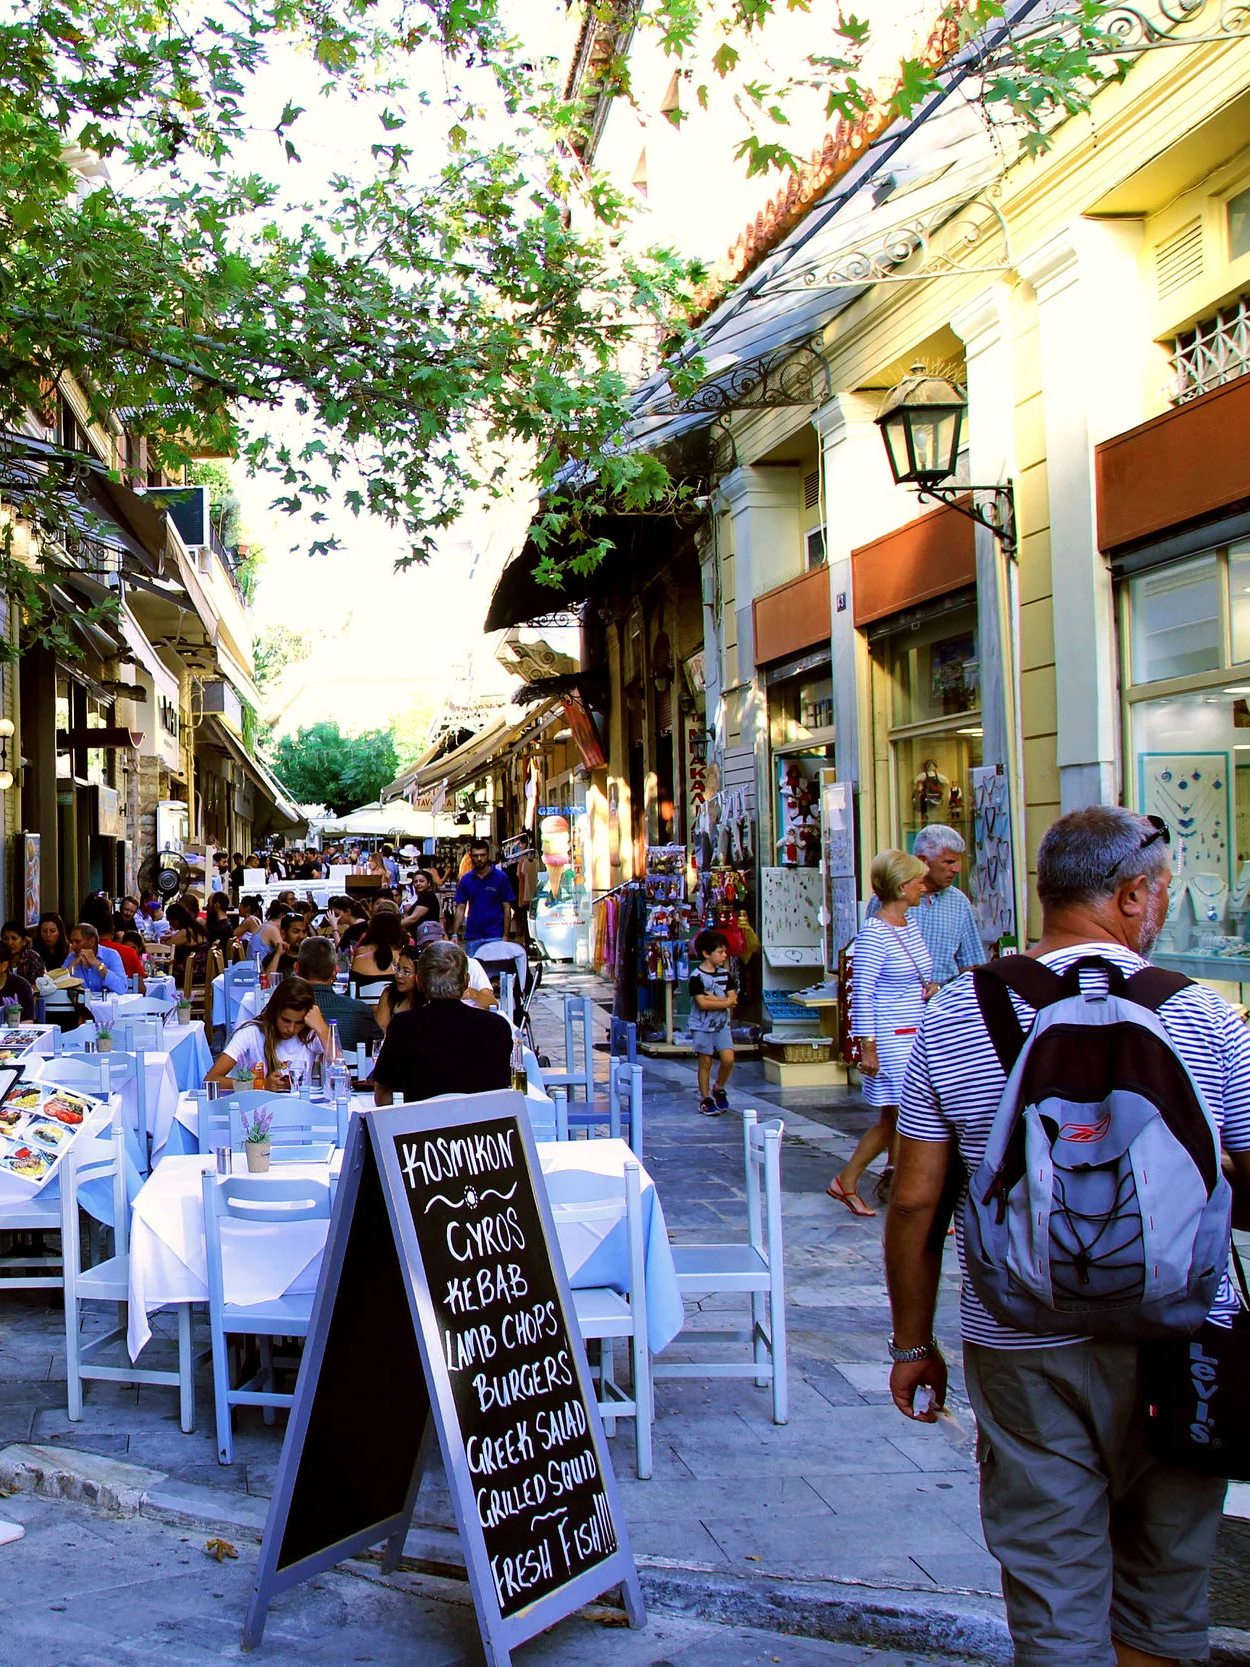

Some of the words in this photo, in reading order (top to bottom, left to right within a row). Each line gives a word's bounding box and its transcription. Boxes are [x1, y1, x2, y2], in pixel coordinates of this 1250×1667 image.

[402, 1128, 515, 1189] KOSMIKON
[446, 1206, 526, 1262] GYROS
[443, 1263, 529, 1315] KEBAB
[445, 1324, 497, 1371] LAMB
[501, 1300, 558, 1349] CHOPS
[472, 1350, 573, 1413] BURGERS
[466, 1420, 535, 1475] GREEK
[535, 1399, 586, 1450] SALAD
[477, 1473, 547, 1528] GRILLED
[547, 1449, 596, 1496] SQUID
[490, 1538, 554, 1609] FRESH
